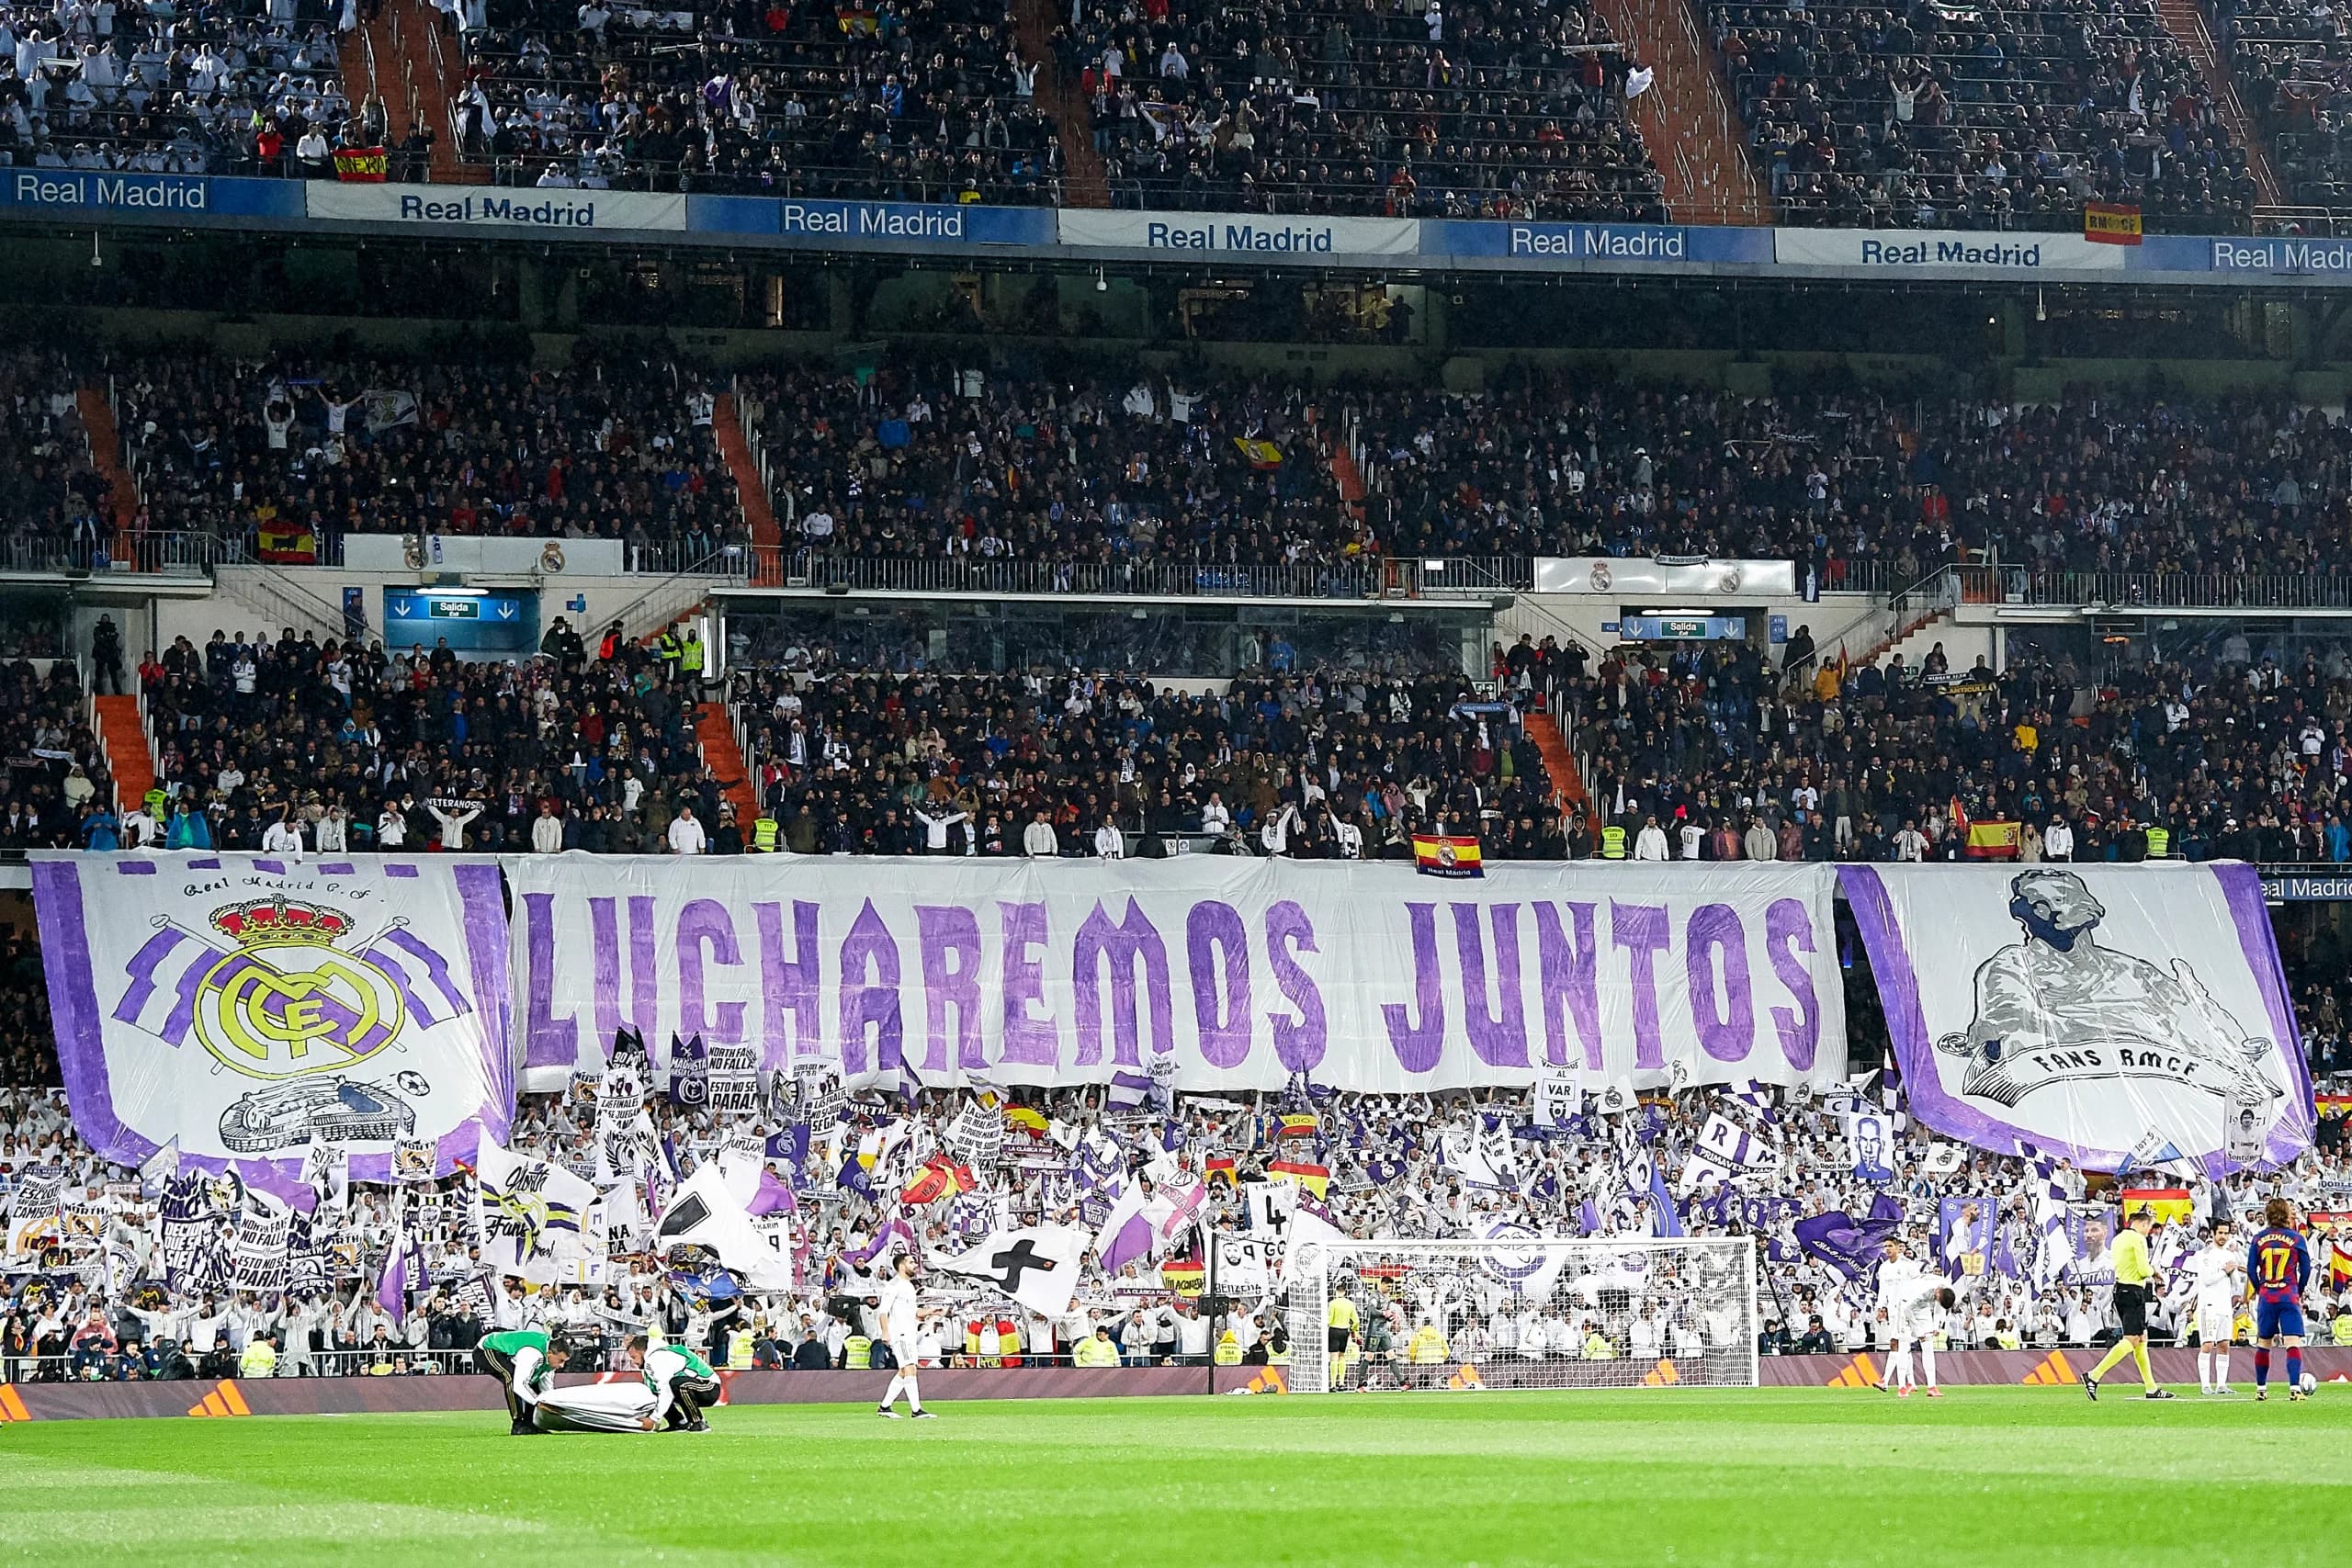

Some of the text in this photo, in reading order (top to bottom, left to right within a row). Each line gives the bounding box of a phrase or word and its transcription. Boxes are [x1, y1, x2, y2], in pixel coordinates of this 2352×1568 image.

[17, 175, 206, 209] Real Madrid
[401, 195, 595, 227] Real Madrid
[784, 205, 963, 237] Real Madrid
[1148, 222, 1333, 253] Real Madrid
[1512, 229, 1684, 256] Real Madrid
[1861, 240, 2041, 267] Real Madrid
[2214, 242, 2352, 271] Real Madr
[440, 602, 469, 612] Salida
[1669, 622, 1698, 631] Salida
[426, 797, 478, 809] VETERANOS
[1684, 830, 1693, 844] 10
[1427, 867, 1472, 876] Real Madrid
[183, 877, 230, 897] Real
[242, 876, 314, 890] Madrid
[2260, 877, 2285, 897] eal
[522, 894, 1822, 1073] LUCHAREMOS JUNTOS
[708, 1046, 748, 1058] NORTH FA
[709, 1058, 723, 1070] NO
[2031, 1047, 2201, 1077] FANS RMCF
[575, 1071, 603, 1084] NORT
[1556, 1070, 1566, 1078] AL
[710, 1081, 757, 1092] ESTO NO SE
[1548, 1084, 1571, 1096] VAR
[601, 1098, 639, 1109] LAS FINALES
[846, 1100, 888, 1115] NORTH
[966, 1104, 975, 1114] LA
[1832, 1101, 1842, 1112] C
[811, 1110, 821, 1120] NO
[962, 1115, 972, 1124] DEL
[972, 1117, 986, 1127] REAL
[1284, 1116, 1310, 1125] EDO
[2256, 1116, 2267, 1126] 71
[812, 1119, 824, 1132] SE
[967, 1126, 982, 1137] PUEDE
[1711, 1122, 1728, 1146] R
[720, 1131, 765, 1154] Juntos
[1698, 1148, 1750, 1174] PRIMAVERA
[1757, 1150, 1777, 1164] M
[505, 1165, 550, 1194] North
[817, 1190, 840, 1199] Madrid
[13, 1203, 57, 1220] CAMISETA
[64, 1203, 105, 1216] NORTH
[1265, 1194, 1287, 1235] 4
[242, 1218, 270, 1234] NORTH
[593, 1213, 603, 1225] M
[757, 1222, 779, 1230] KARIM
[484, 1213, 529, 1244] Fans
[607, 1224, 631, 1240] NA
[240, 1231, 258, 1243] NO
[258, 1230, 287, 1246] FALLA
[769, 1235, 781, 1253] 9
[2257, 1234, 2295, 1247] GRIEZMANN
[290, 1246, 323, 1259] NORTH
[1243, 1245, 1256, 1261] 9
[188, 1245, 234, 1282] FANS
[238, 1254, 287, 1269] ESTO NO SE
[2260, 1247, 2290, 1280] 17
[590, 1263, 601, 1277] F
[2066, 1268, 2113, 1285] CAPITÁN
[236, 1268, 285, 1288] PARA!
